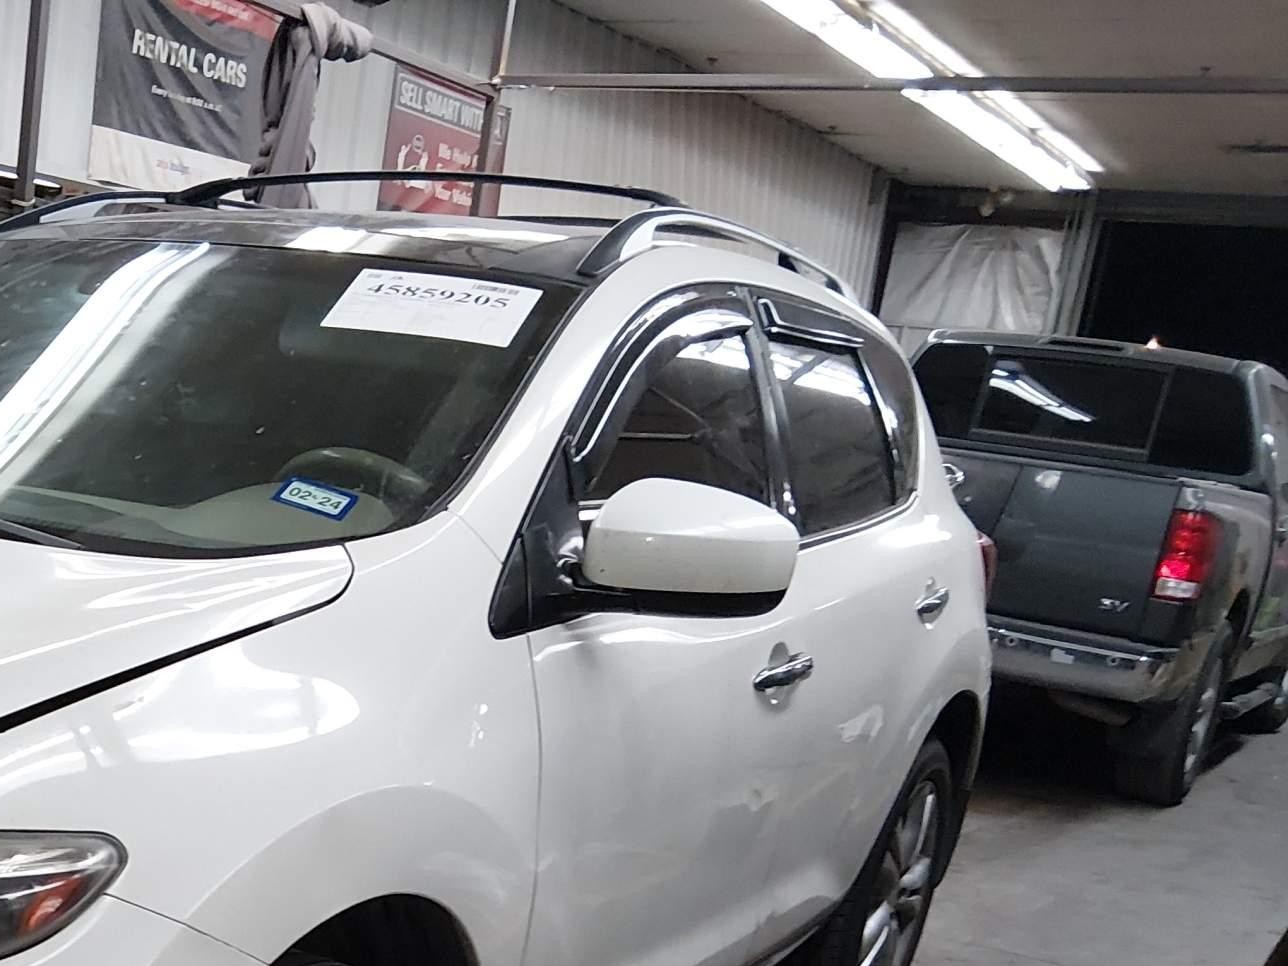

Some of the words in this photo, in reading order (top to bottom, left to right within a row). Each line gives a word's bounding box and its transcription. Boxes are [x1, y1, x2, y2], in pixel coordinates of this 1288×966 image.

[132, 28, 199, 74] RENTAL
[202, 52, 248, 88] CARS
[399, 80, 424, 110] SELL
[423, 90, 460, 122] SMART
[367, 282, 511, 310] 45859205
[1098, 598, 1131, 612] SV
